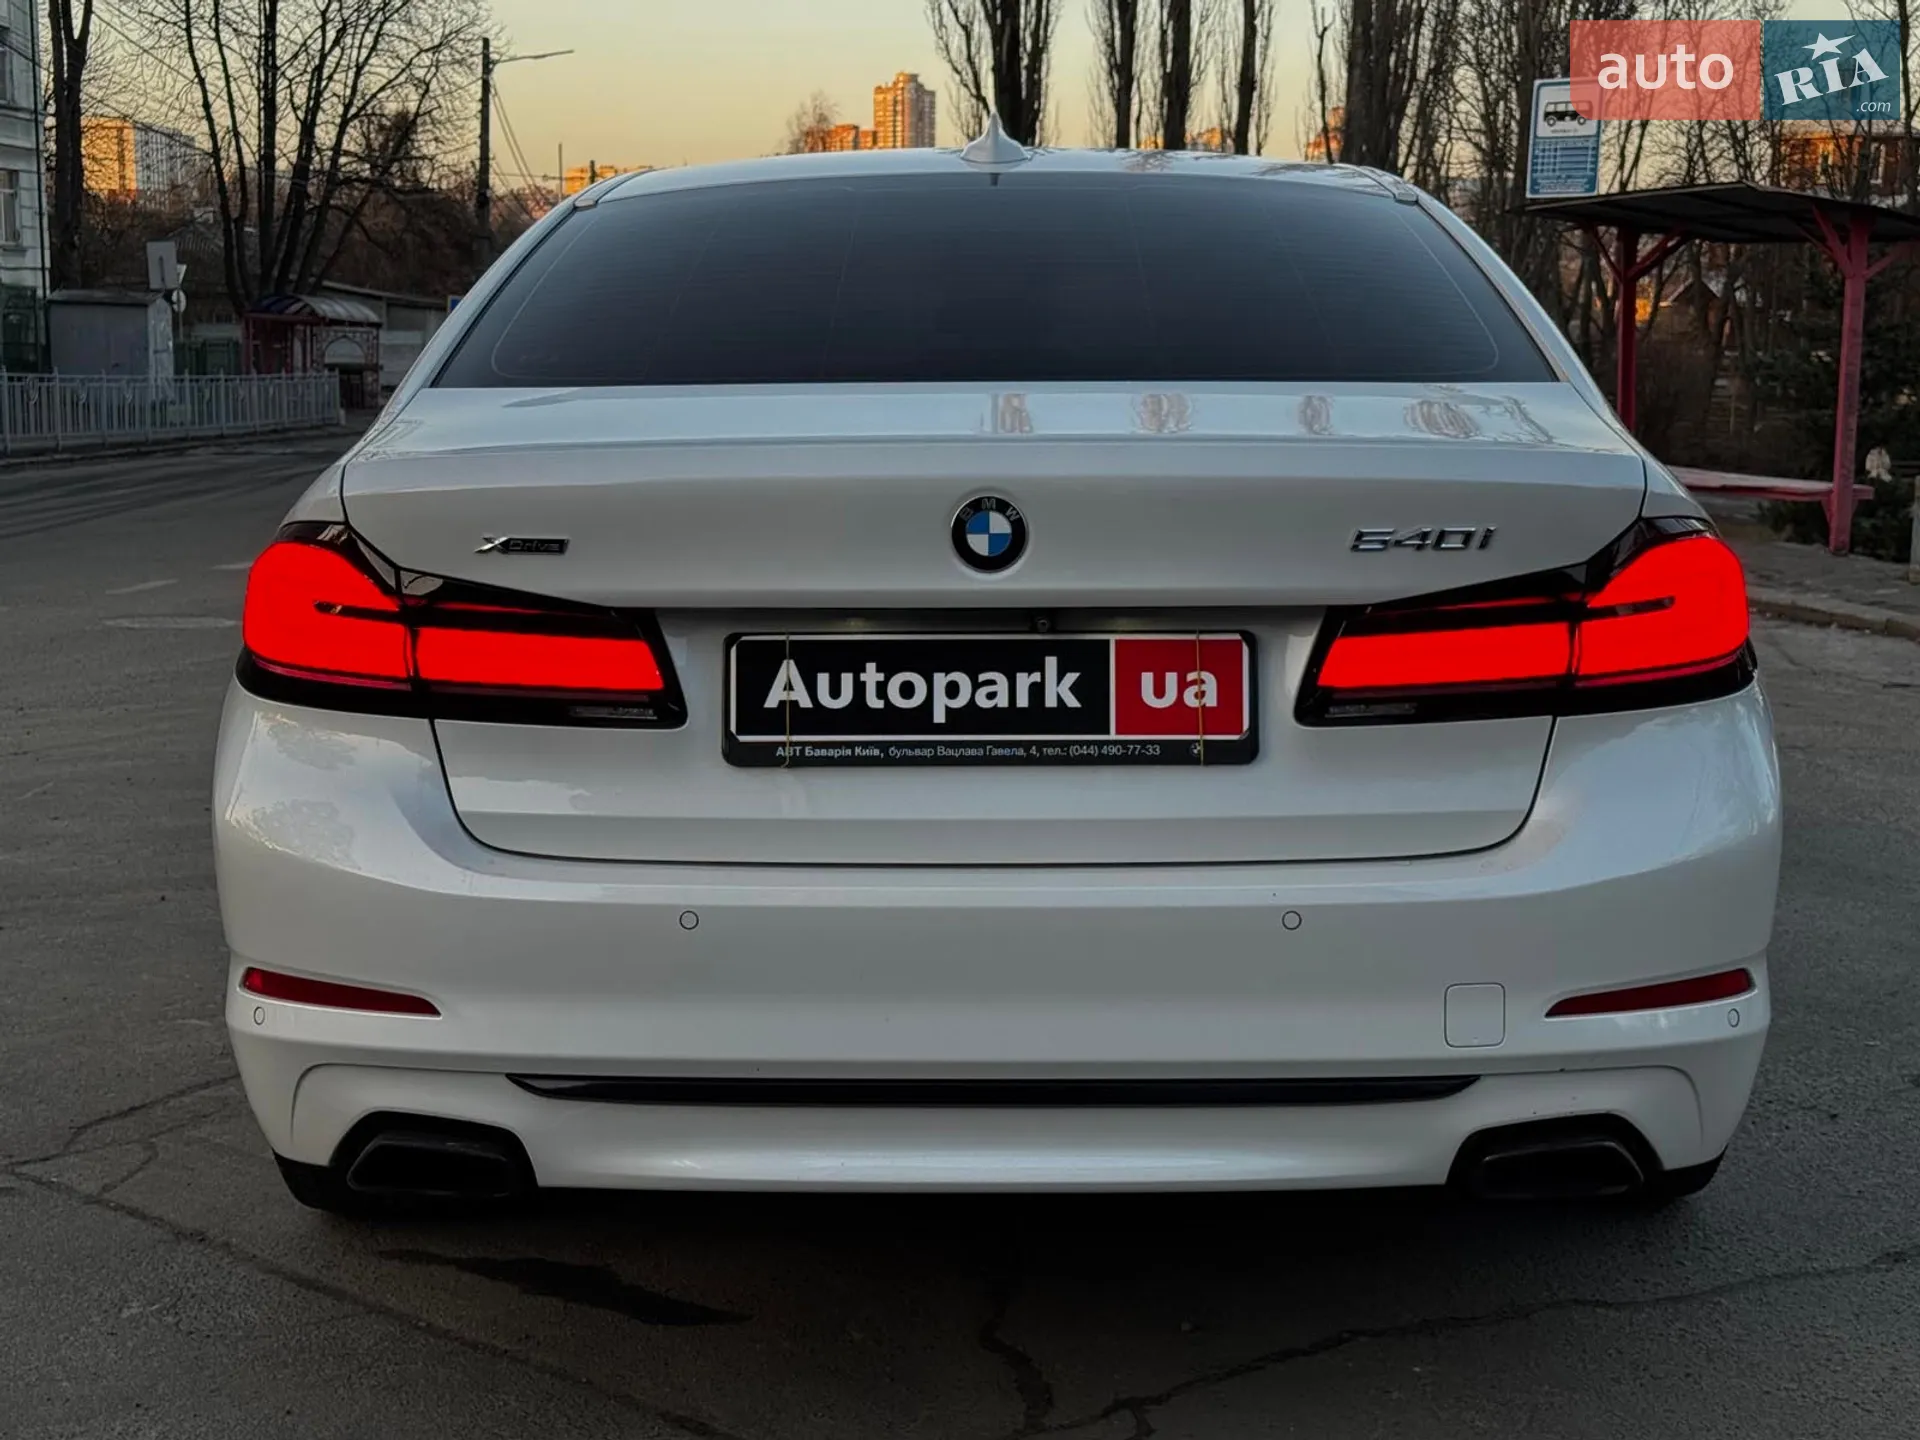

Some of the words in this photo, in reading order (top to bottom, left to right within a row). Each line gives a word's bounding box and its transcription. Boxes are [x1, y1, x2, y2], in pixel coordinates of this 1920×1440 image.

[1350, 527, 1497, 551] 540i
[763, 656, 1081, 723] Autopark
[1140, 671, 1219, 708] ua
[804, 745, 851, 758] Баварія
[854, 745, 885, 758] Київ,
[888, 745, 935, 758] бульвар
[937, 746, 984, 757] Вацлава
[986, 745, 1027, 758] Гавела,
[1029, 745, 1040, 757] 4,
[1069, 744, 1099, 757] (044)
[1101, 744, 1161, 756] 490-77-33
